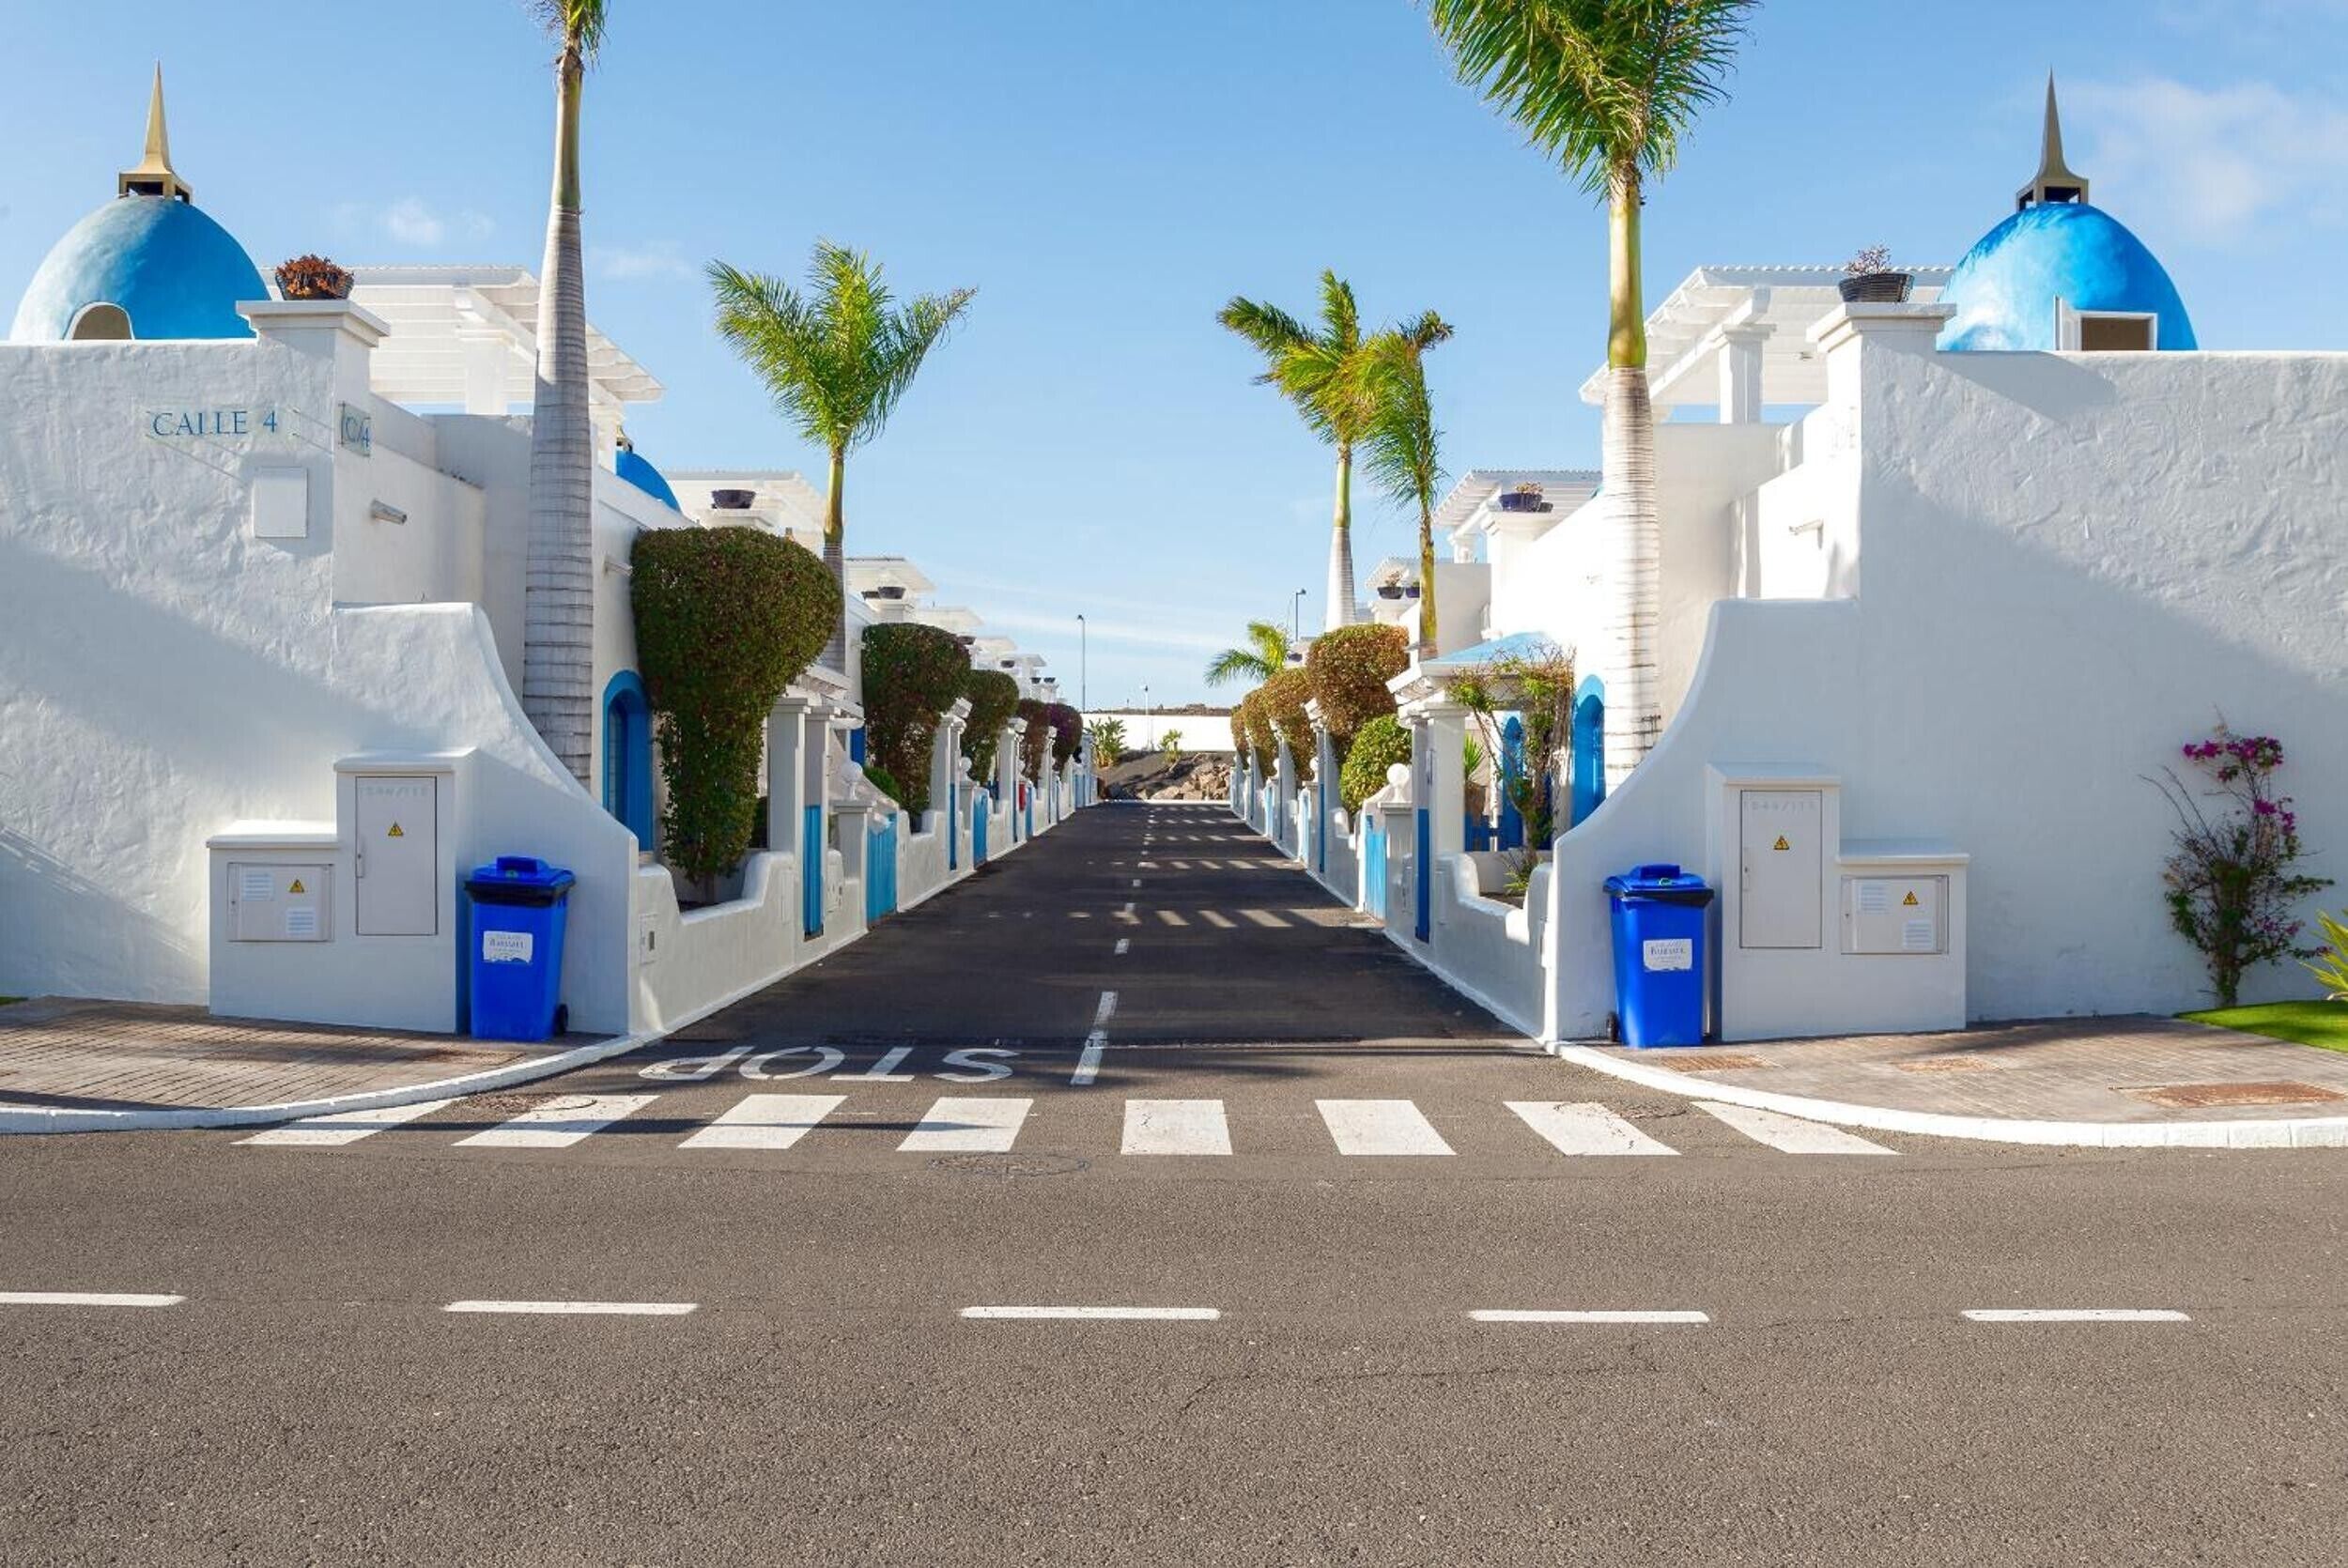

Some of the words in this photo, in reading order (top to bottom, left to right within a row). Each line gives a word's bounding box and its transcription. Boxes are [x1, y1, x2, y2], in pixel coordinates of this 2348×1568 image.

[153, 410, 248, 436] CALLE
[262, 410, 278, 434] 4
[639, 1045, 1021, 1083] STOP
